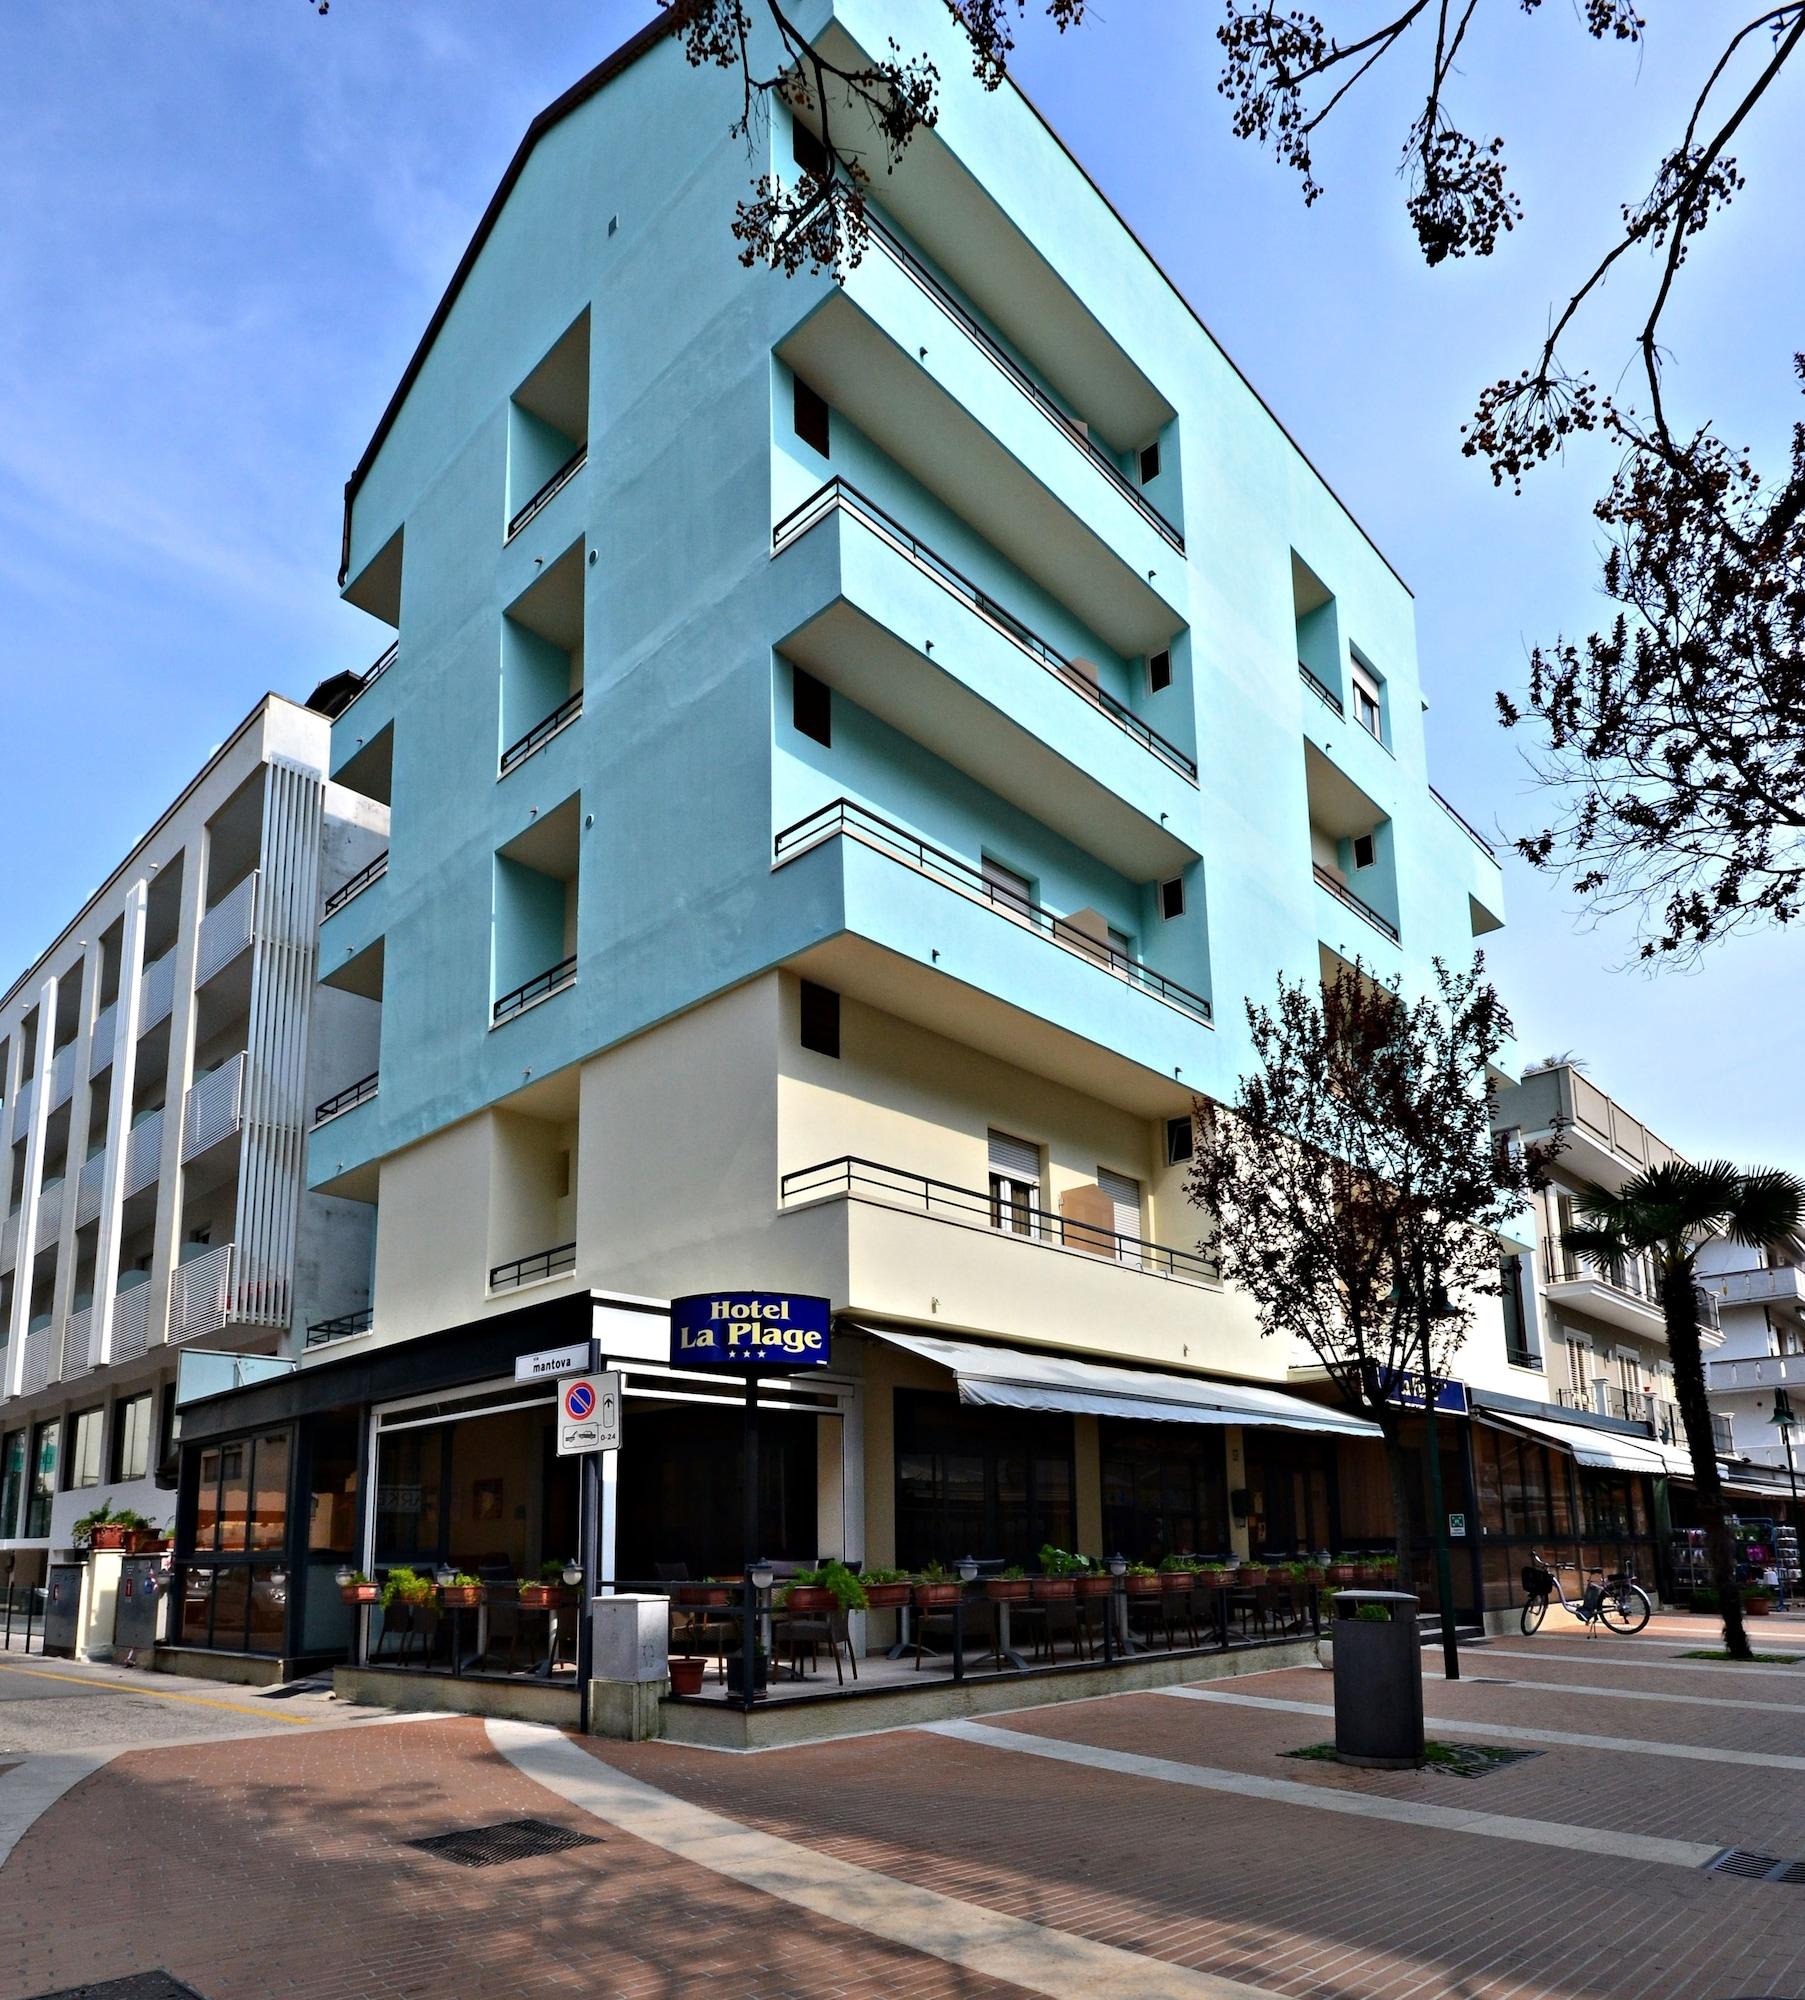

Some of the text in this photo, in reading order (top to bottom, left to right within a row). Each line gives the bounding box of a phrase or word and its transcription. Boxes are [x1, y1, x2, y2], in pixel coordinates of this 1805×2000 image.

[710, 1300, 790, 1320] Hotel
[680, 1322, 823, 1353] La Plage
[533, 1358, 571, 1373] mantova
[600, 1433, 616, 1441] 0-24
